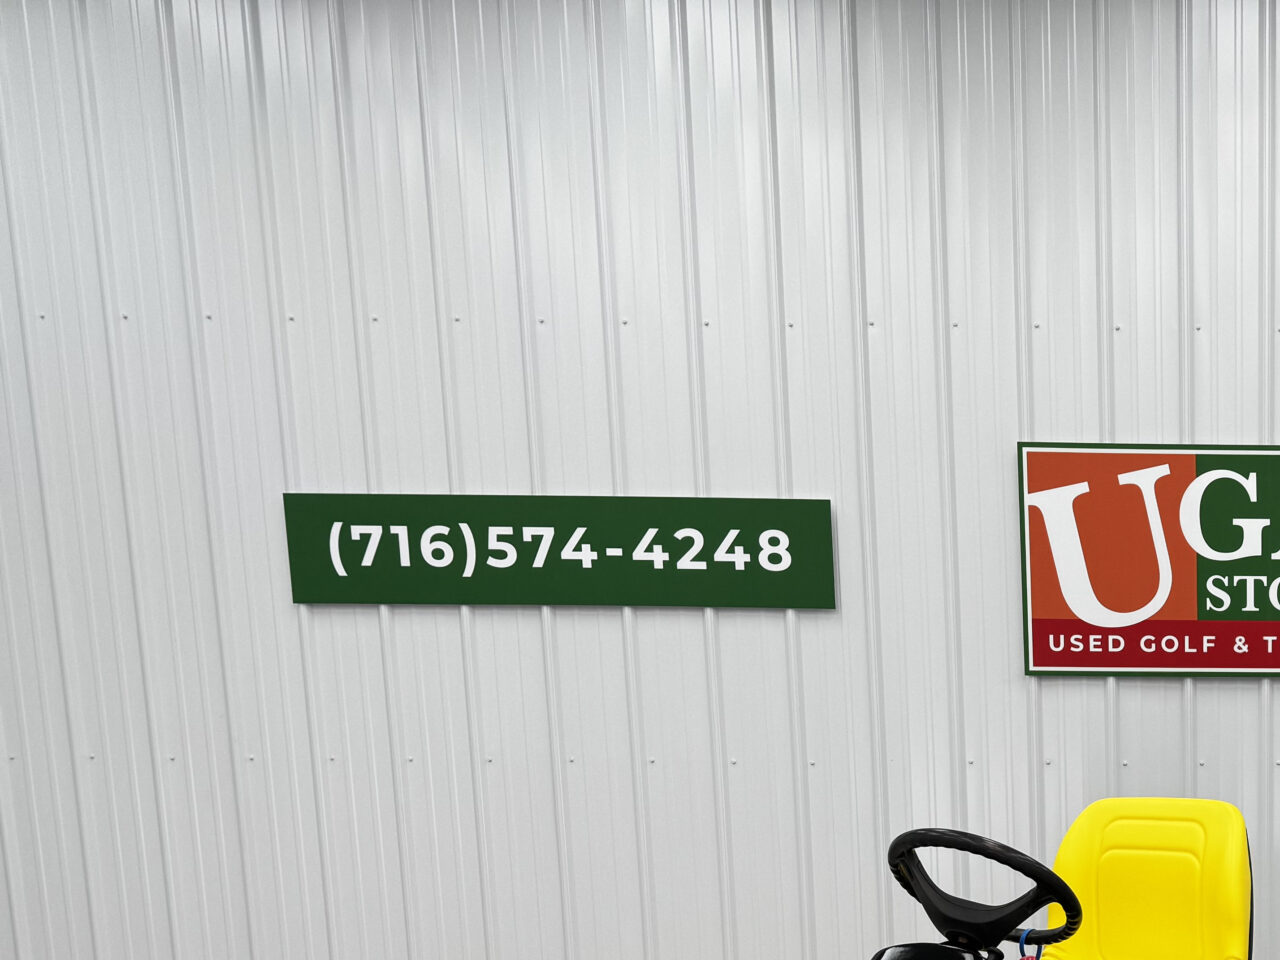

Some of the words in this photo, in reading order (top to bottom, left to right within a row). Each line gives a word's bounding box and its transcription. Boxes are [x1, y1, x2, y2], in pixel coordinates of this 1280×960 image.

[328, 521, 793, 578] (716)574-4248
[1048, 634, 1126, 653] USED
[1139, 634, 1217, 654] GOLF
[1232, 635, 1250, 655] &
